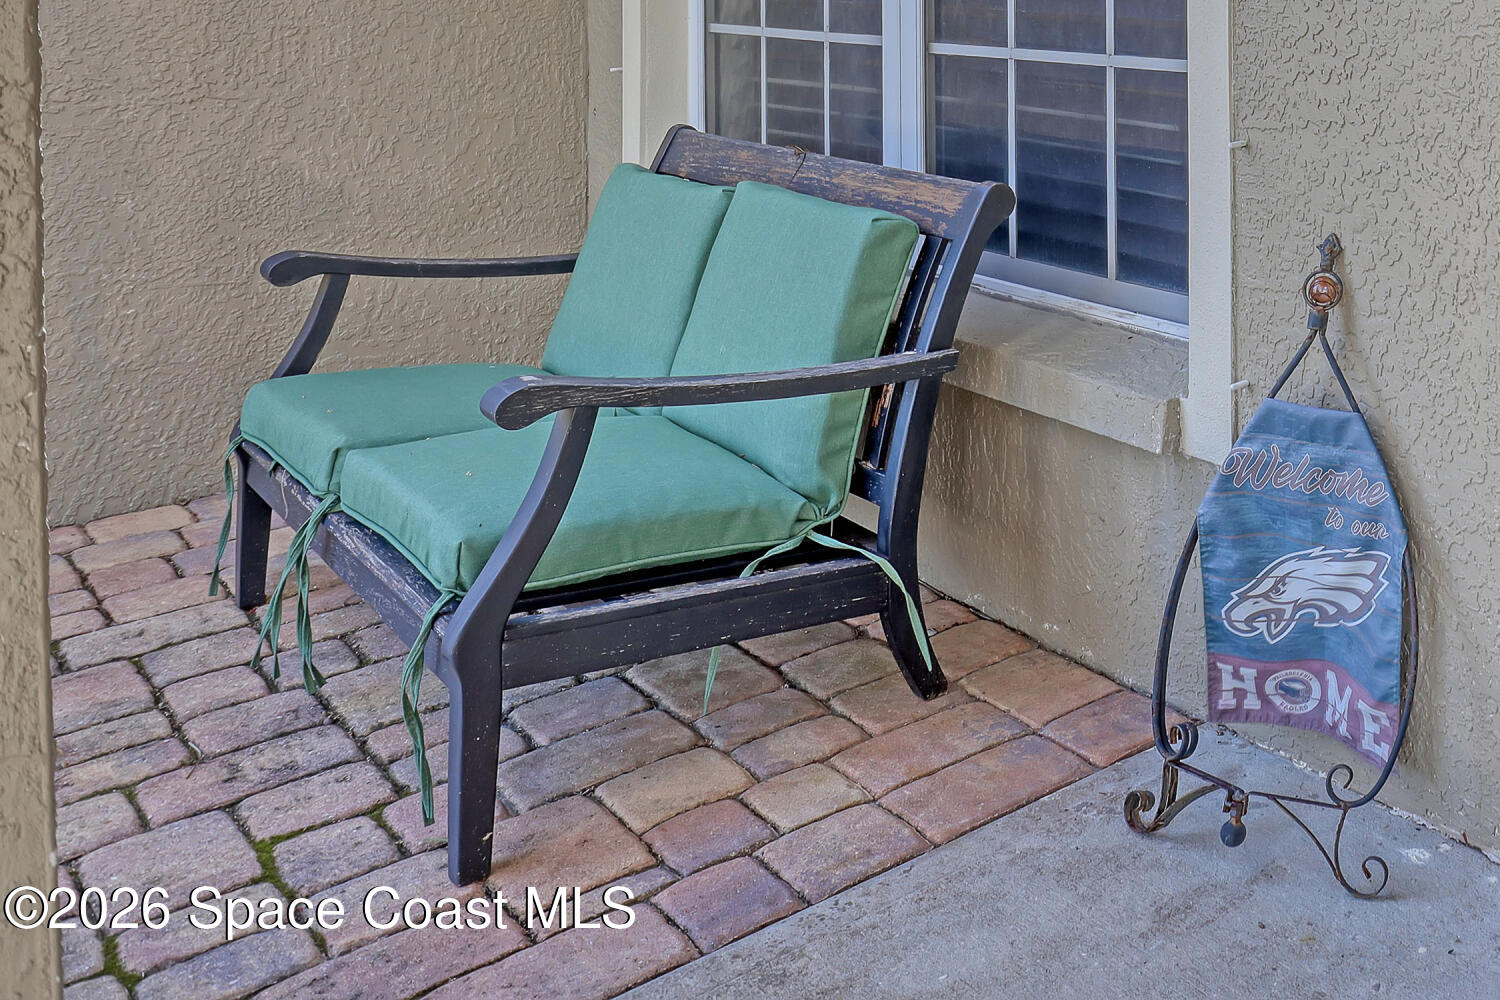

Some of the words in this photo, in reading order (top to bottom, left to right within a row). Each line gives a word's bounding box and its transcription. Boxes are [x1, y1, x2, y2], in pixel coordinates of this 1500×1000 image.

[1220, 444, 1390, 507] Welcome
[1324, 506, 1344, 530] to
[1351, 520, 1389, 540] our
[1216, 661, 1391, 763] HOME
